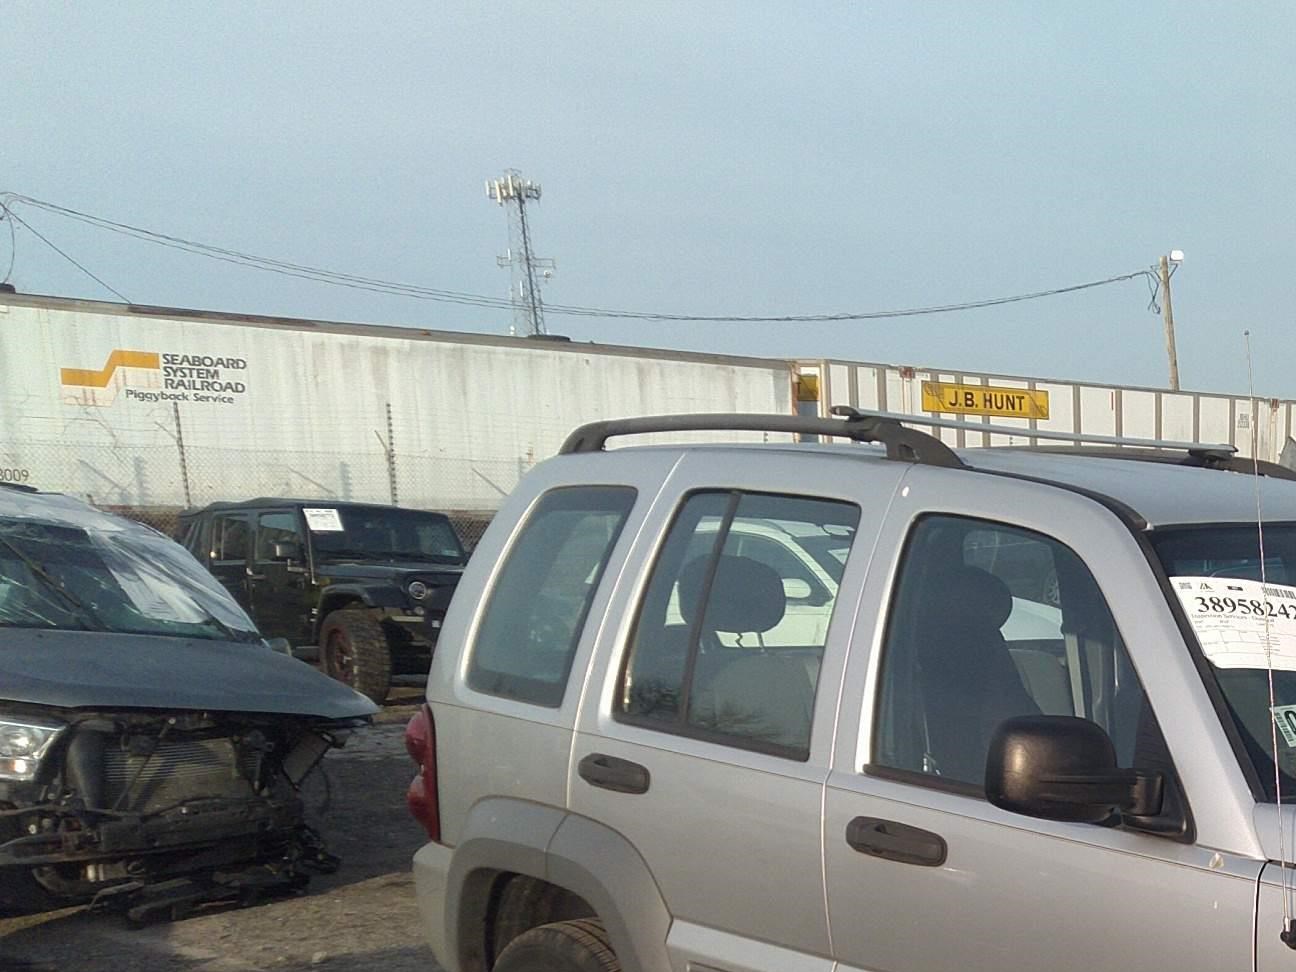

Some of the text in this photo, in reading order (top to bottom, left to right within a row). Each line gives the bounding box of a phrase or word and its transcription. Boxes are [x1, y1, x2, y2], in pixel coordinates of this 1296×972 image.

[162, 353, 247, 370] SEABOARD
[163, 366, 220, 380] SYSTEM
[164, 378, 246, 393] RAILROAD
[125, 389, 234, 404] Piggyback Service
[949, 391, 1025, 411] J.B. HUNT
